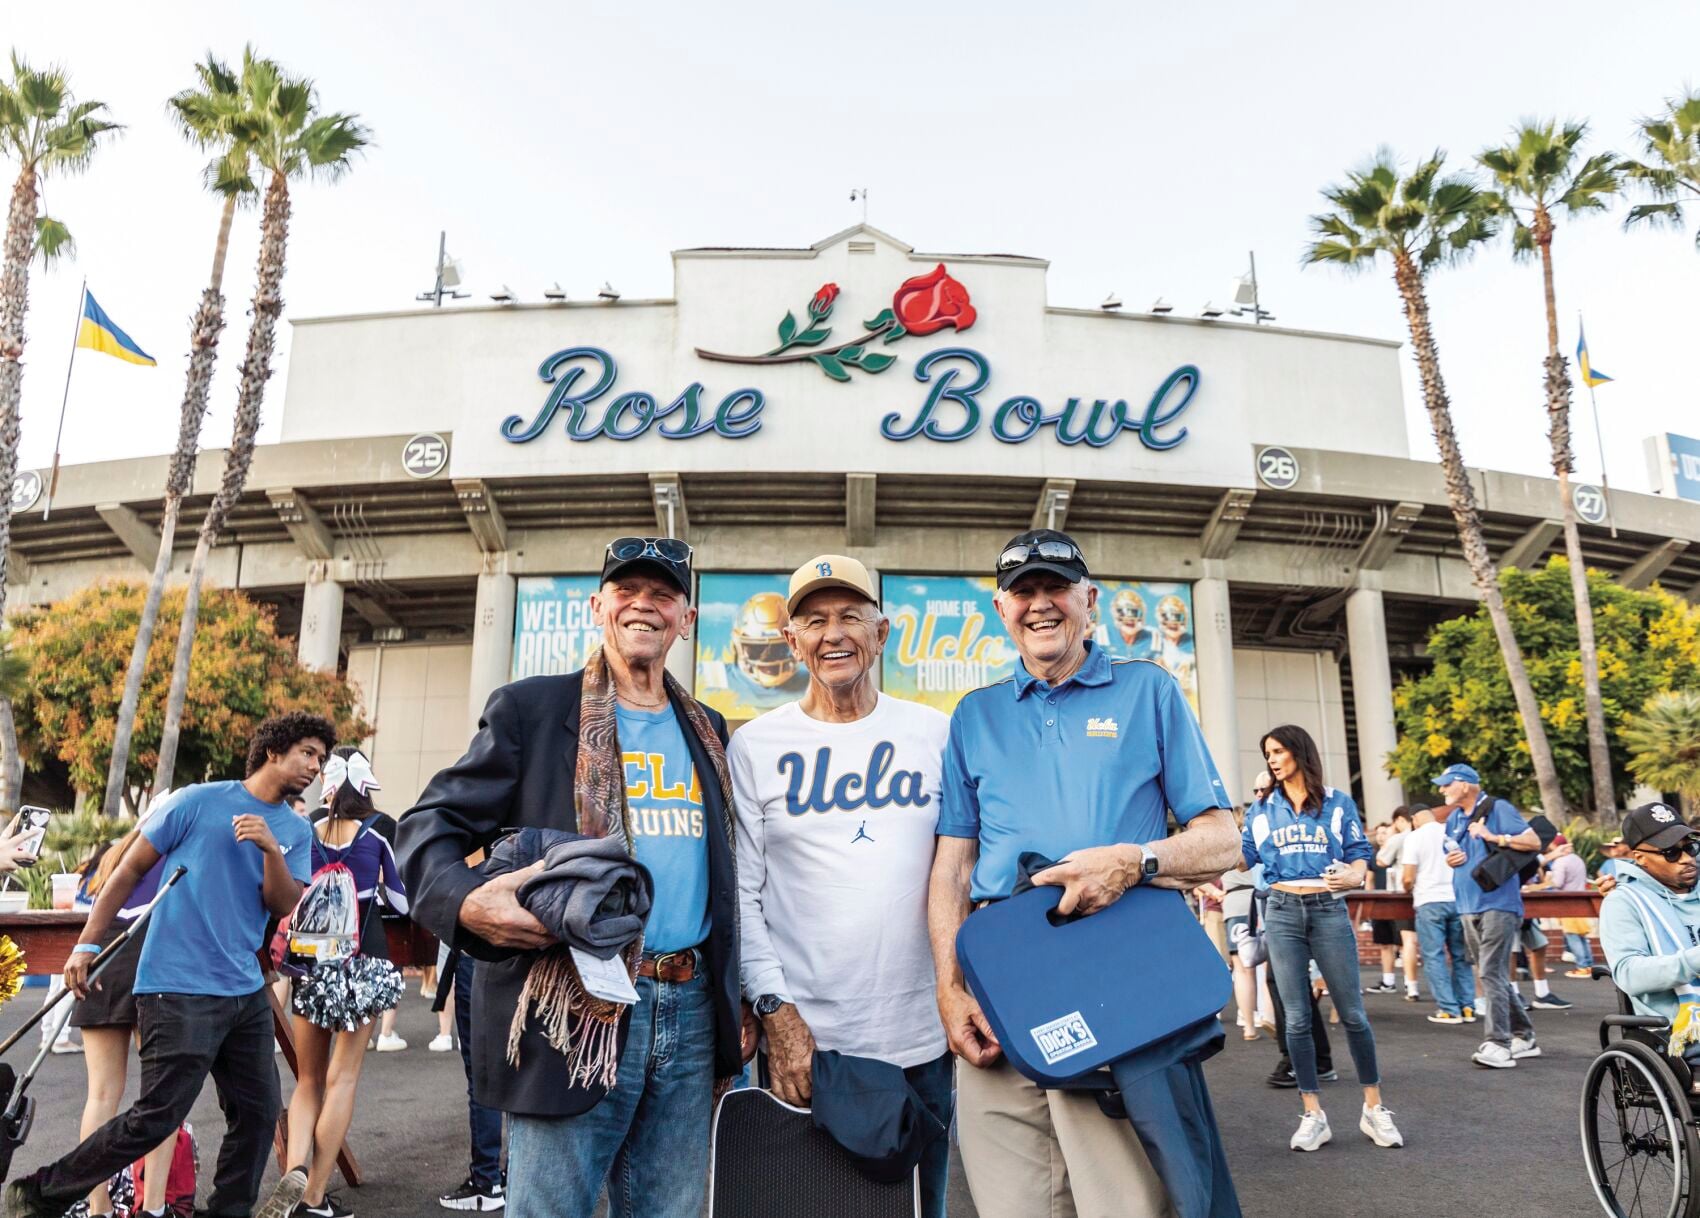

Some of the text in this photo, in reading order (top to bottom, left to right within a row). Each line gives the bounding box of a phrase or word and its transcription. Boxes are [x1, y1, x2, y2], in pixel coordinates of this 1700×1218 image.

[500, 346, 1201, 450] Rose Bowl
[407, 442, 442, 468] 25
[1261, 455, 1294, 480] 26
[12, 477, 37, 503] 24
[1577, 491, 1602, 515] 27
[815, 561, 833, 578] B
[521, 600, 595, 631] WELCO
[926, 600, 978, 617] HOME OF
[895, 612, 1007, 667] Ucla
[621, 752, 703, 806] CL
[776, 740, 932, 818] Ucla
[629, 807, 703, 838] RUINS
[1272, 824, 1329, 848] UCLA
[1304, 843, 1328, 854] TEAM
[1039, 1020, 1087, 1054] DICK'S
